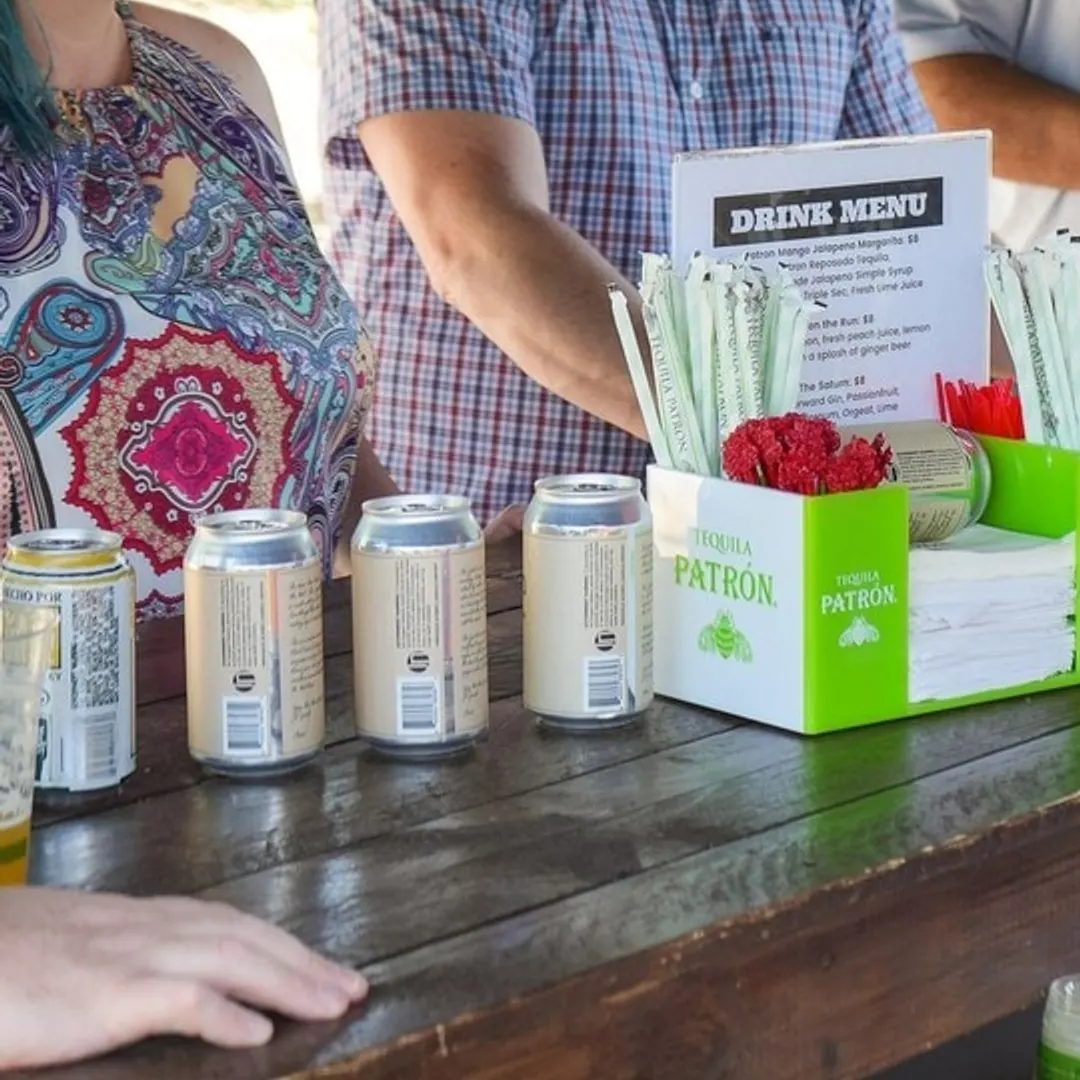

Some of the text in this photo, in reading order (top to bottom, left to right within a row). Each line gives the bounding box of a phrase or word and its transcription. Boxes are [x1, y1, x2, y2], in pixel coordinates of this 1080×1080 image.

[730, 192, 928, 234] DRINK MENU
[778, 247, 811, 258] Mango
[809, 256, 854, 270] Reposado
[855, 268, 886, 281] Simple
[888, 265, 914, 277] Syrup
[803, 287, 829, 300] Triple
[851, 284, 876, 294] Fresh
[876, 281, 899, 293] Lime
[900, 279, 924, 291] Juice
[822, 319, 838, 329] the
[822, 334, 845, 344] fresh
[847, 330, 875, 343] peach
[902, 323, 931, 335] lemon
[818, 348, 847, 362] splash
[848, 346, 859, 357] of
[860, 343, 889, 358] ginger
[890, 340, 912, 351] beer
[800, 382, 816, 393] The
[876, 403, 899, 413] Lime
[693, 528, 753, 556] TEQUILA
[835, 569, 881, 588] TEQUILA
